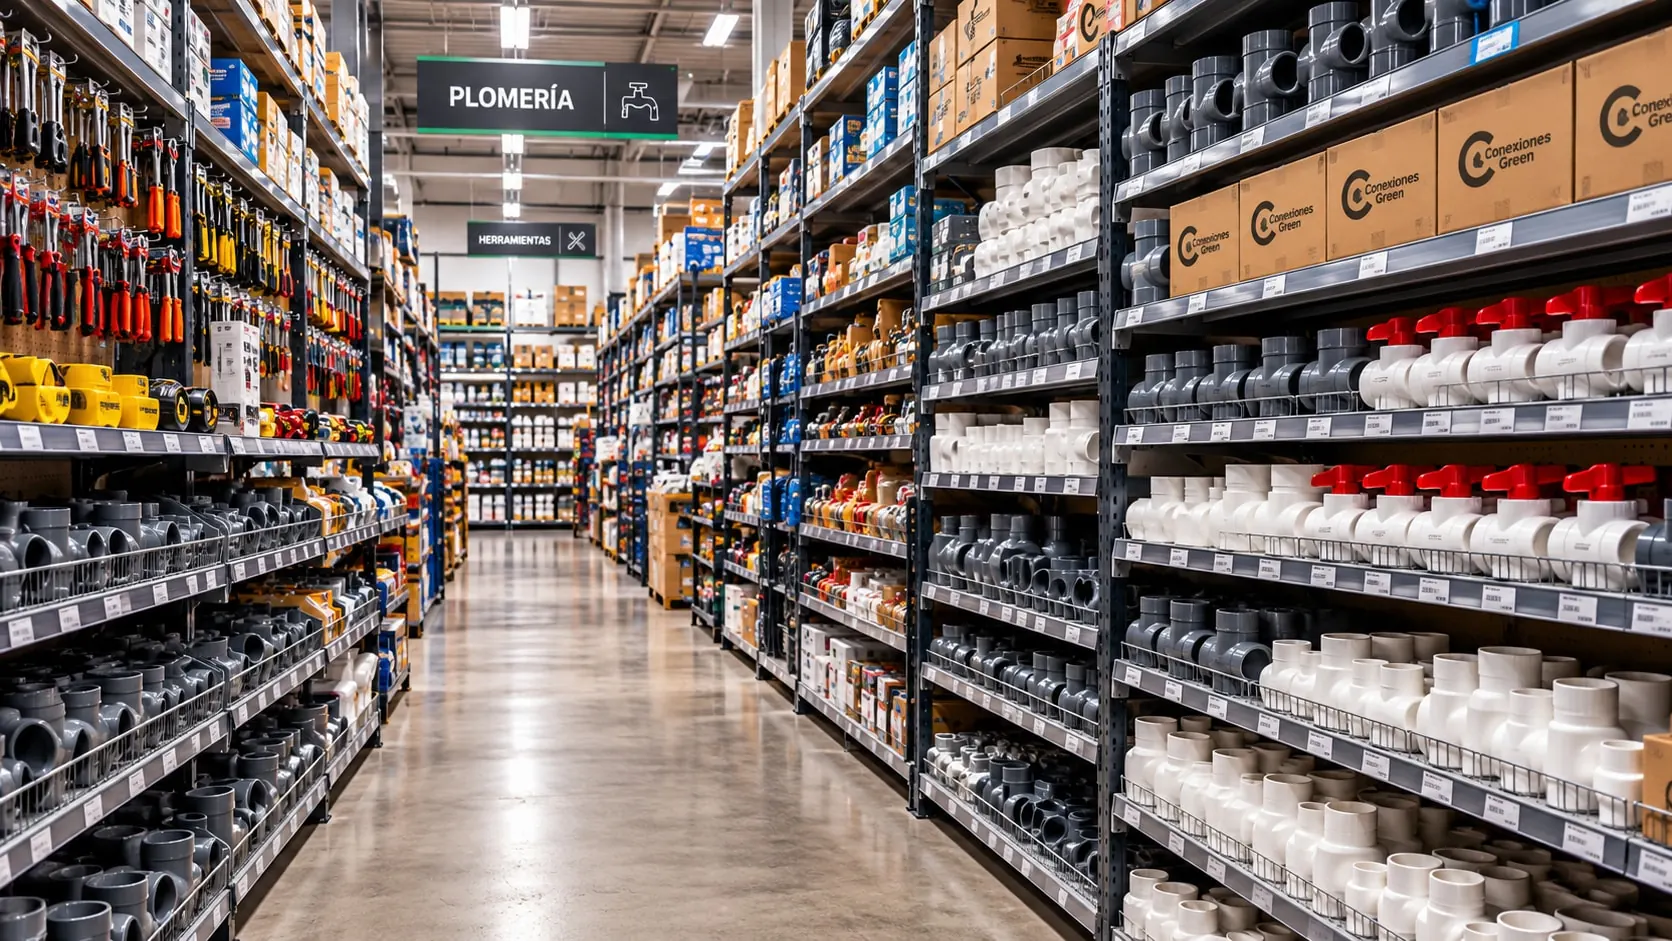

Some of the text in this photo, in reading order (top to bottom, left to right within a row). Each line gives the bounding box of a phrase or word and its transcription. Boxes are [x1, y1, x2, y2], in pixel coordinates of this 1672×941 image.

[449, 83, 574, 110] PLOMERÍA
[1632, 97, 1672, 117] Conex
[1648, 112, 1672, 128] Gre
[1484, 132, 1551, 160] Conexiones
[1499, 151, 1534, 170] Green
[1365, 172, 1419, 195] Conexiones
[1375, 189, 1404, 204] Green
[1278, 220, 1301, 232] Green
[479, 235, 551, 246] HERRAMIENTAS
